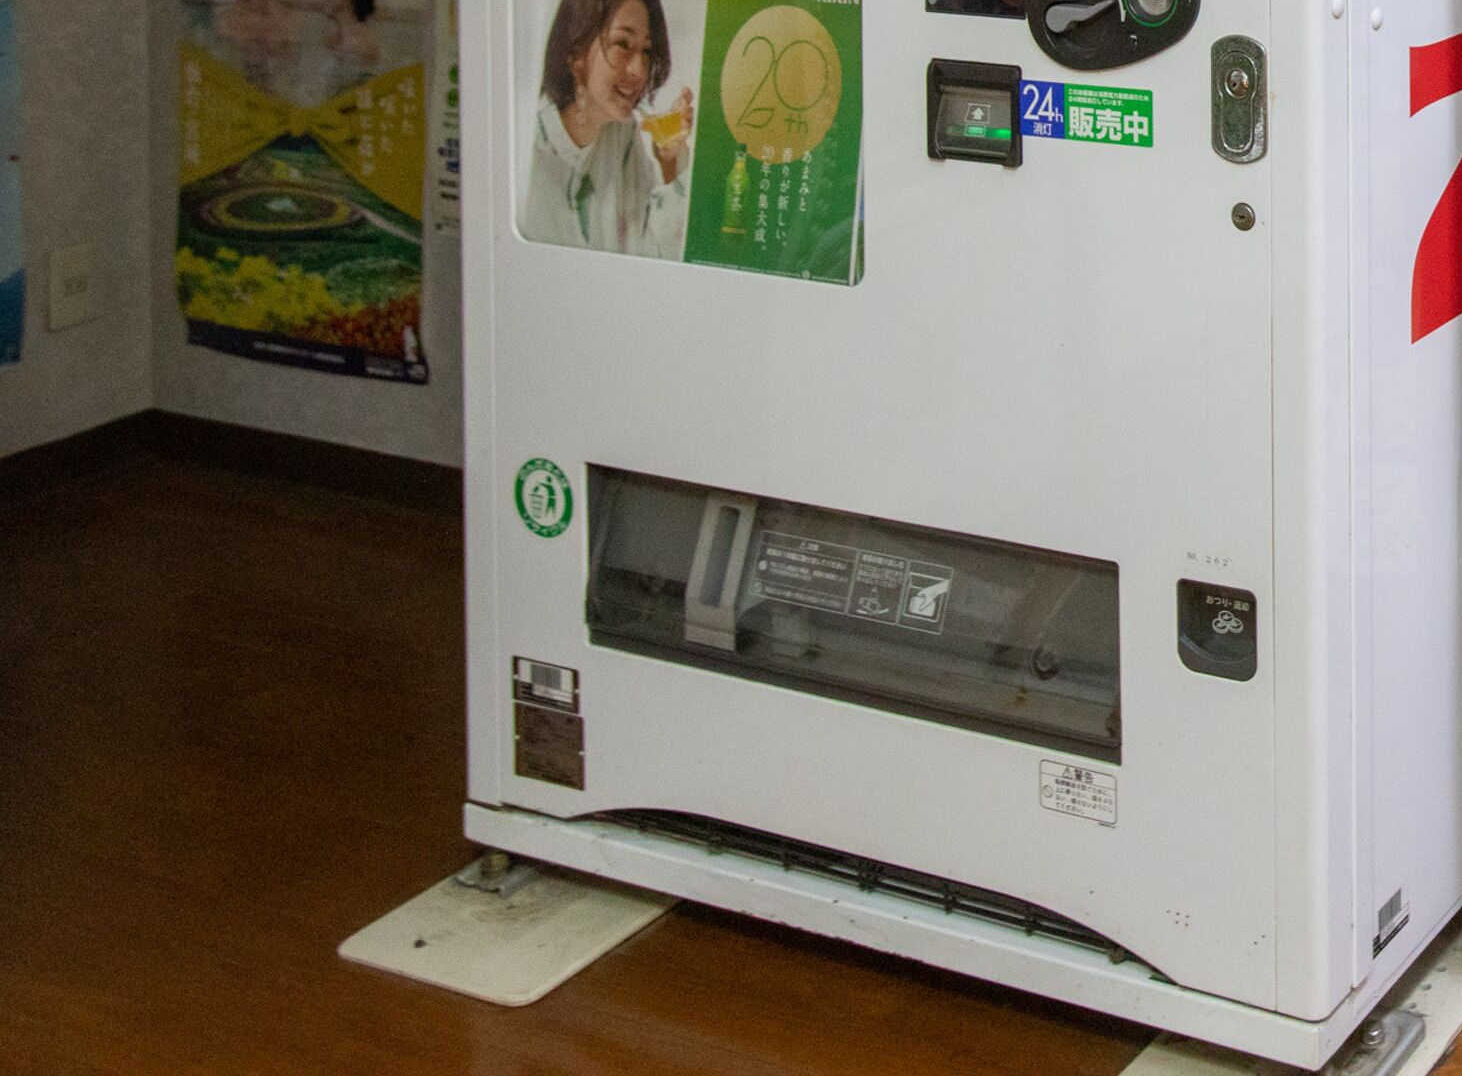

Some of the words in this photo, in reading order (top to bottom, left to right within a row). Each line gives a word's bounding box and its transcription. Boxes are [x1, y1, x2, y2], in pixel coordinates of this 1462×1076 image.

[1022, 83, 1065, 124] 24h
[1032, 122, 1053, 136] 消灯
[1068, 105, 1150, 144] 販売中
[775, 145, 793, 248] 香りが新しい。
[800, 148, 814, 212] あまみと
[1204, 554, 1230, 568] 262
[1074, 766, 1095, 785] 警告
